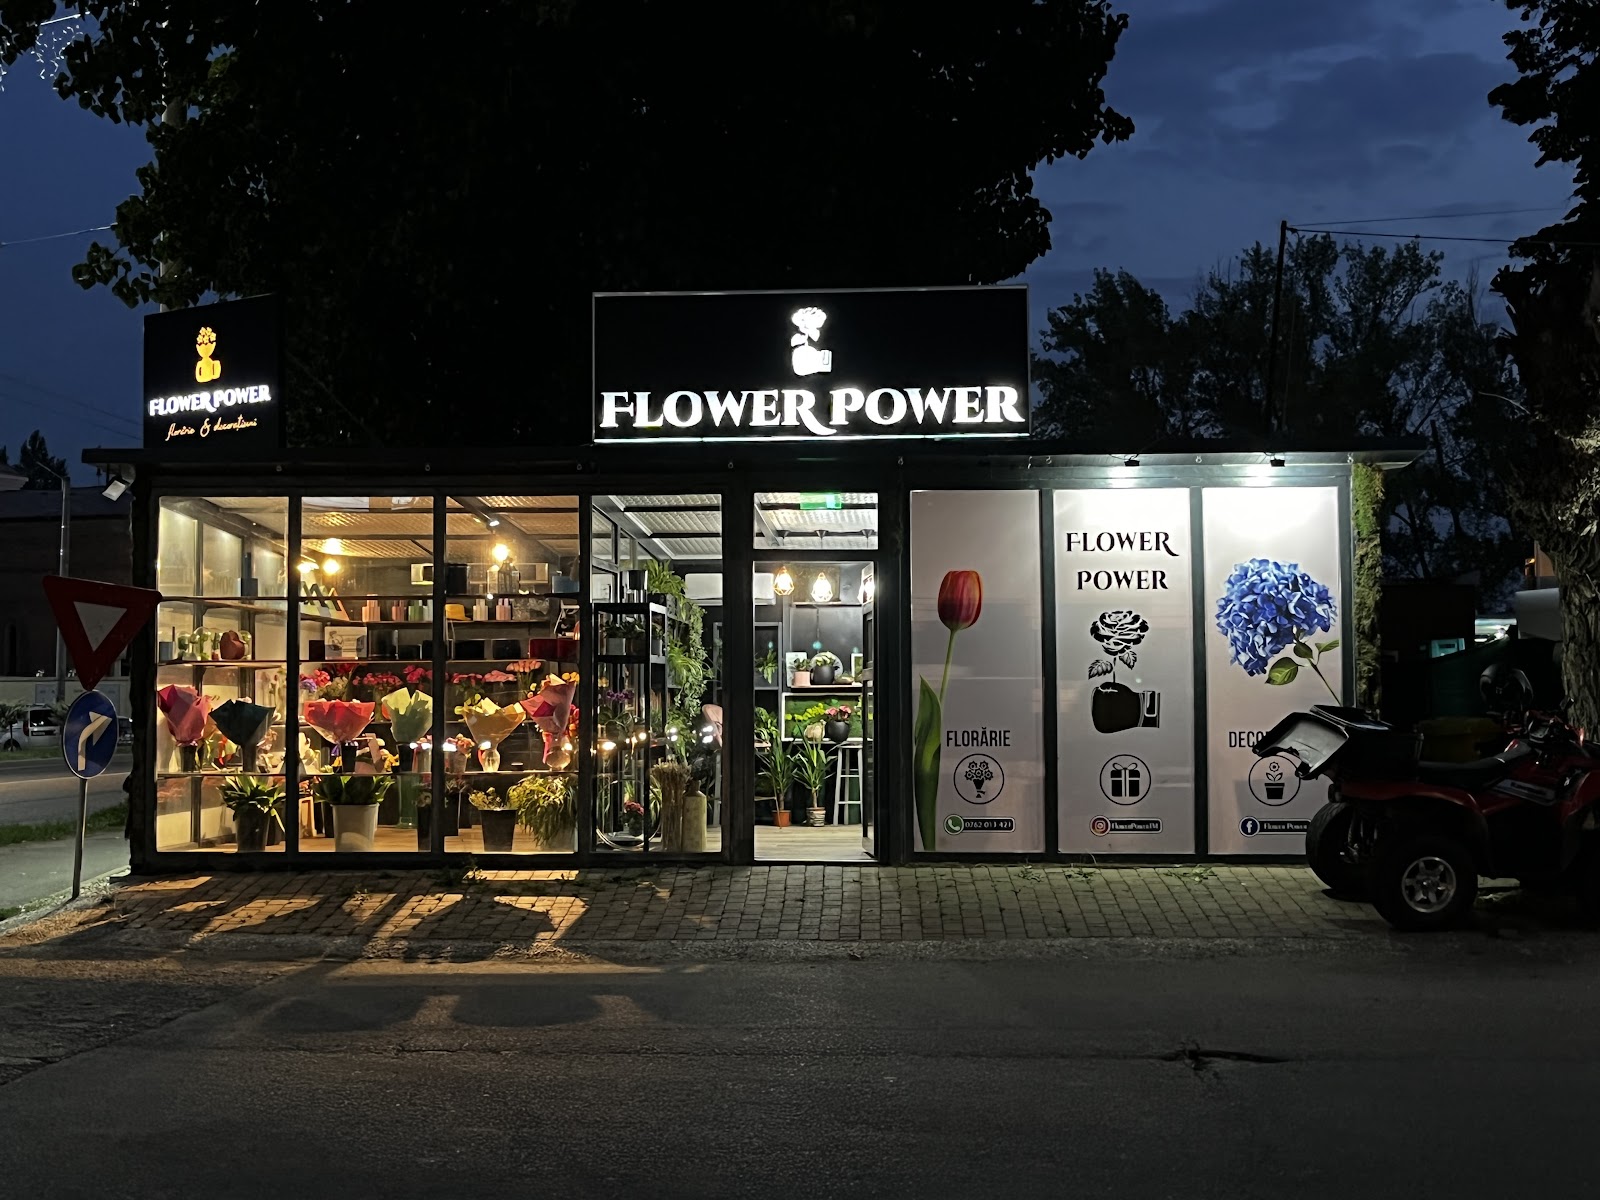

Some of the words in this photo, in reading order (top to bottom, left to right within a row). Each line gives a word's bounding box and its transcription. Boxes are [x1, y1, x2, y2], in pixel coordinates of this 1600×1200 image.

[149, 391, 217, 416] FLOWER
[213, 385, 271, 406] POWER
[600, 389, 837, 436] FLOWER
[829, 386, 1025, 426] POWER
[200, 418, 212, 437] &
[1066, 531, 1180, 557] FLOWER
[1077, 570, 1169, 590] POWER
[946, 727, 1011, 747] FLORĂRIE
